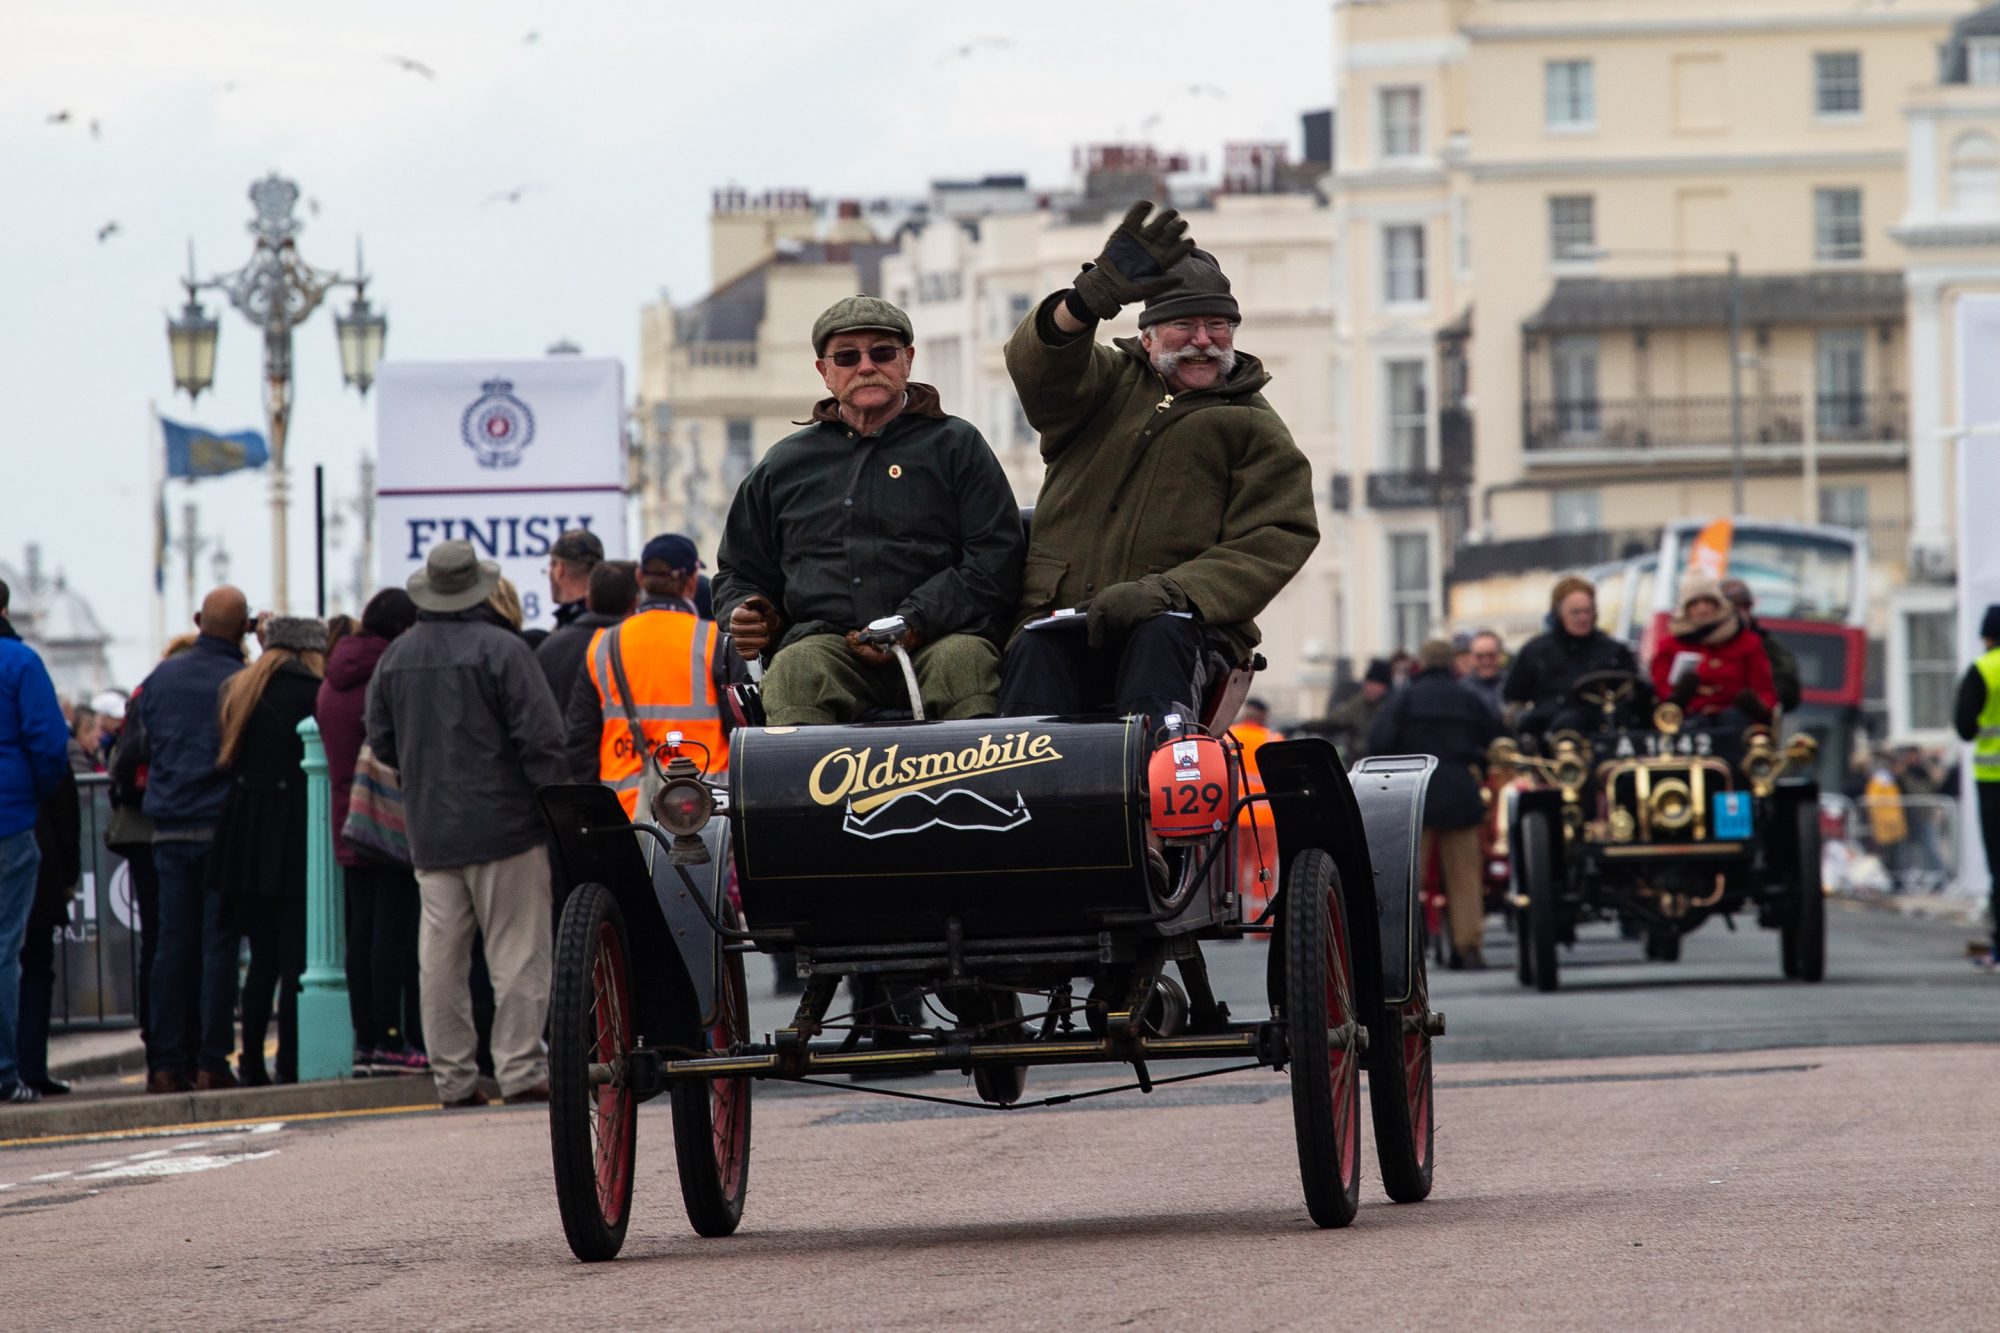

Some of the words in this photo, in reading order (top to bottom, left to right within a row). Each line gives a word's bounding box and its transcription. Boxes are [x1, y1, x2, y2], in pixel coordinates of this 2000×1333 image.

[1615, 736, 1635, 757] A
[808, 731, 1063, 806] Oldsmobile
[1161, 782, 1223, 816] 129
